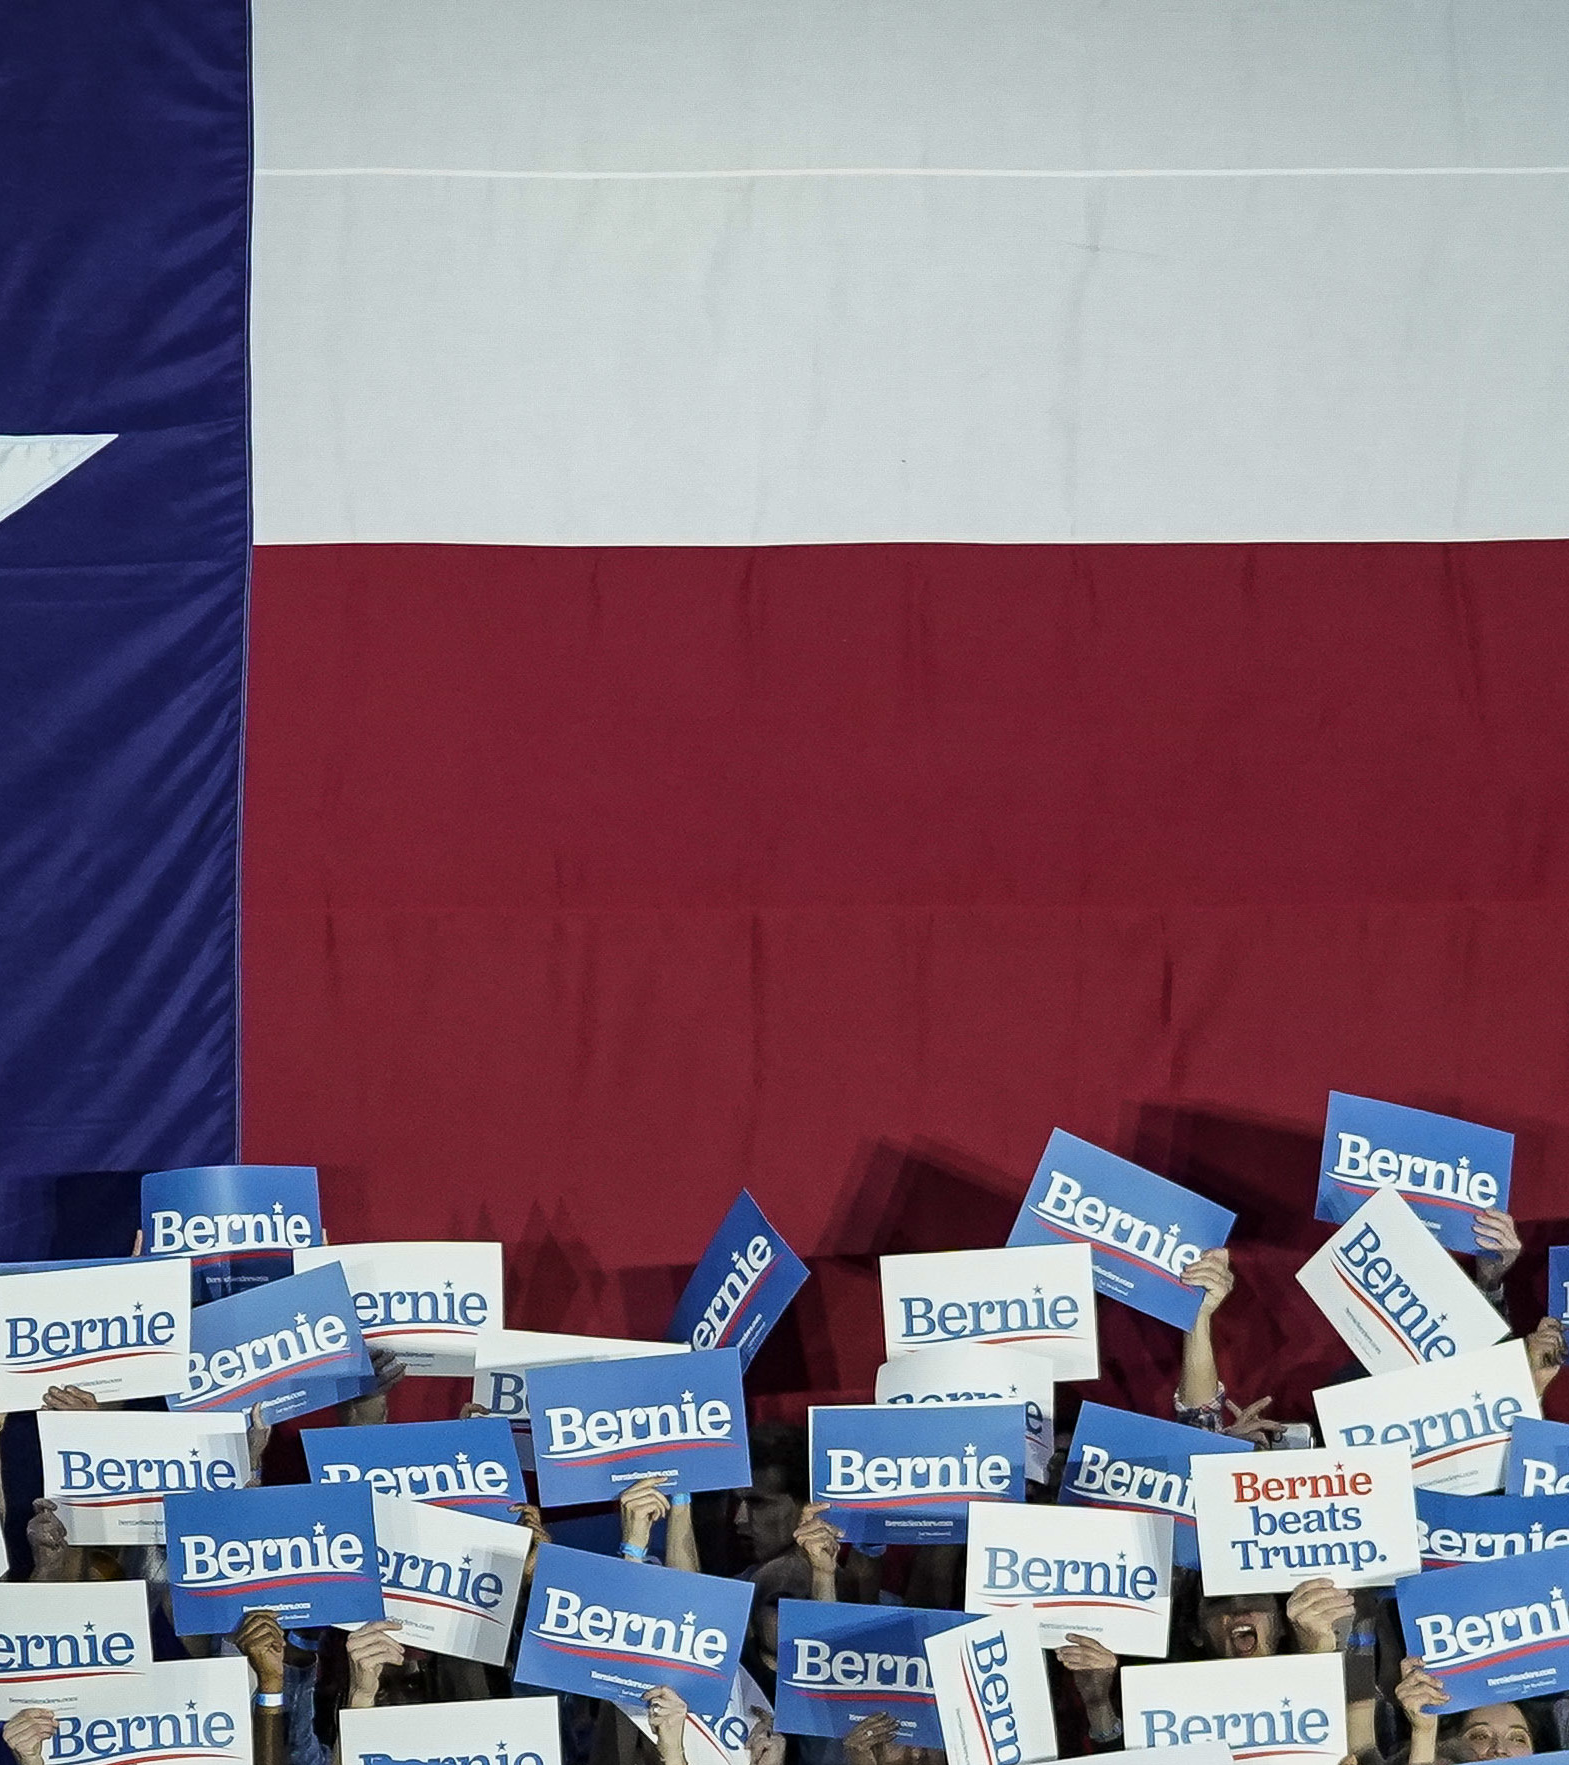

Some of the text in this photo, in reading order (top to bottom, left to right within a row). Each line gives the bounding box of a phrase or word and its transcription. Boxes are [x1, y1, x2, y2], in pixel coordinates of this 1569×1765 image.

[1332, 1132, 1498, 1210] Bernie
[151, 1202, 312, 1254] Bernie
[356, 1280, 488, 1327] ernie
[686, 1234, 773, 1356] ernie
[899, 1284, 1079, 1341] Bernie
[1340, 1223, 1456, 1358] Bernie
[4, 1301, 176, 1358] Bernie
[182, 1312, 349, 1396] Bernie
[544, 1389, 733, 1454] Bernie
[59, 1448, 236, 1494] Bernie
[826, 1443, 1011, 1496] Bernie
[1232, 1461, 1374, 1504] Bernie
[1251, 1502, 1362, 1538] beats
[180, 1522, 364, 1582] Bernie
[984, 1548, 1158, 1604] Bernie
[1231, 1539, 1388, 1573] Trump.
[537, 1587, 728, 1669] Bernie
[793, 1637, 930, 1691] Bern
[50, 1700, 234, 1760] Bernie
